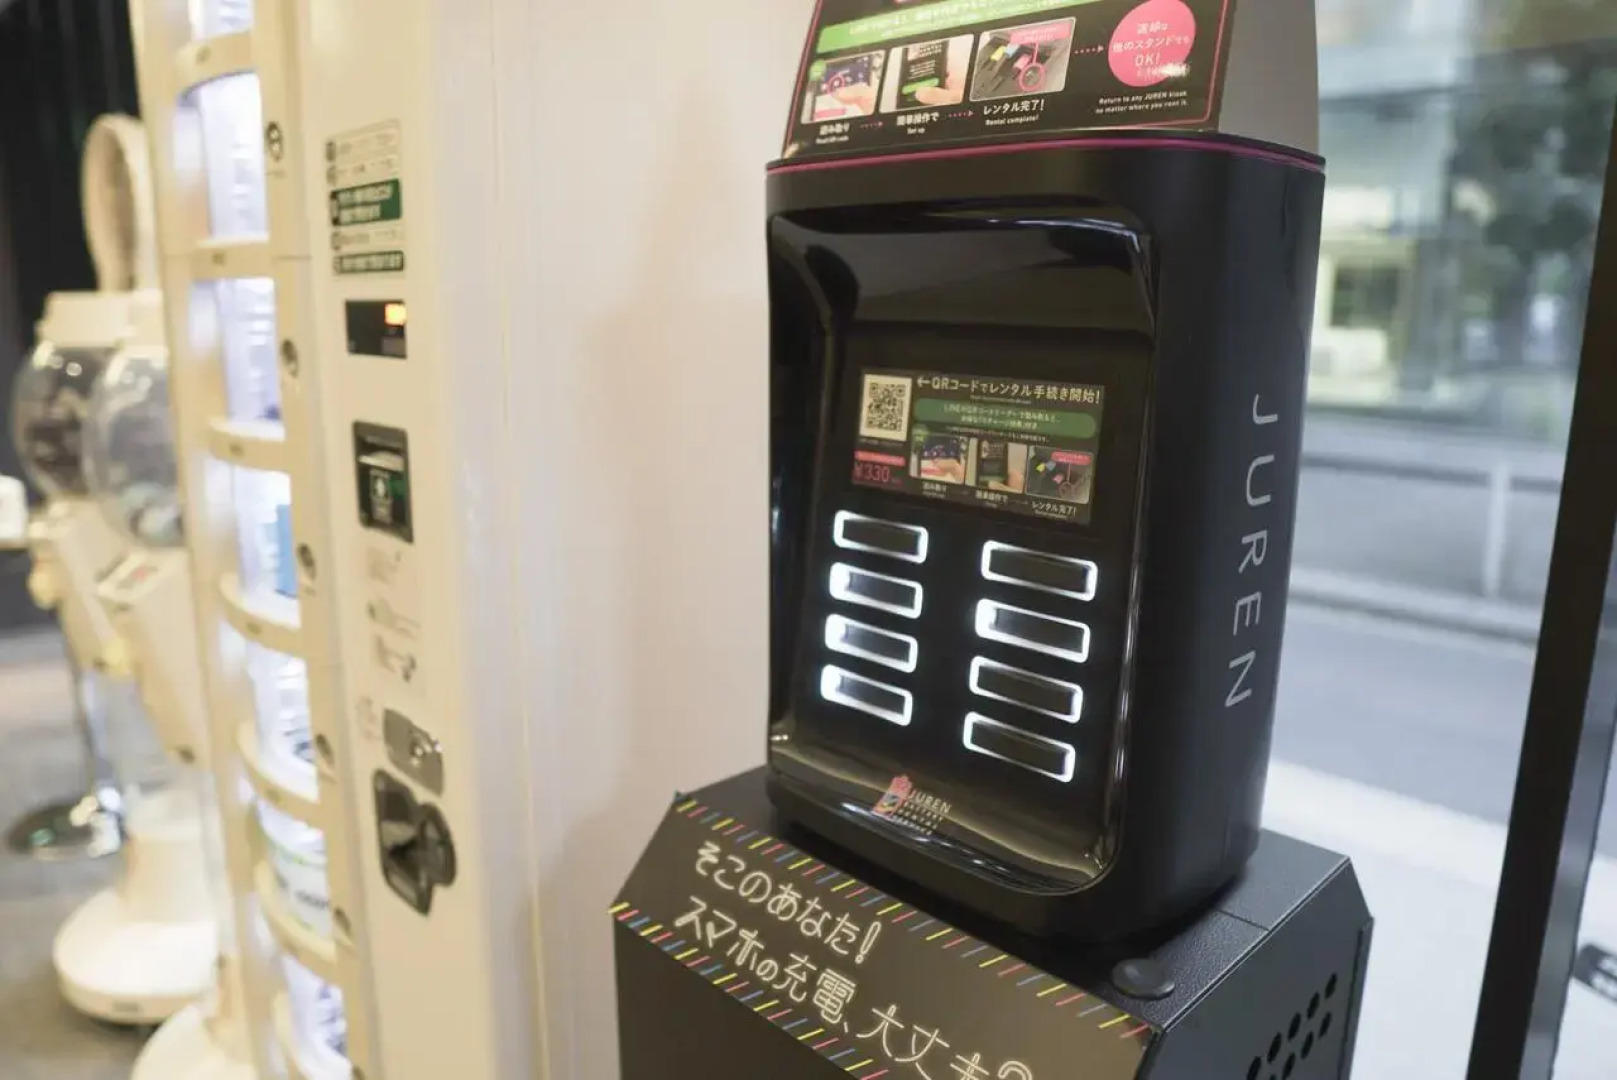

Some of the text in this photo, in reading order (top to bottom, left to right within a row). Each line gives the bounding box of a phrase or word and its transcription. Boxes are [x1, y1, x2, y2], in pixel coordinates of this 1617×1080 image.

[1135, 53, 1161, 67] OK!
[983, 98, 1045, 115] レンタル完了!
[931, 376, 1100, 405] QRコードでレンタル手続き開始!
[1225, 393, 1279, 707] JUREN
[908, 789, 952, 814] JUREN
[695, 840, 882, 965] そこのあなた!
